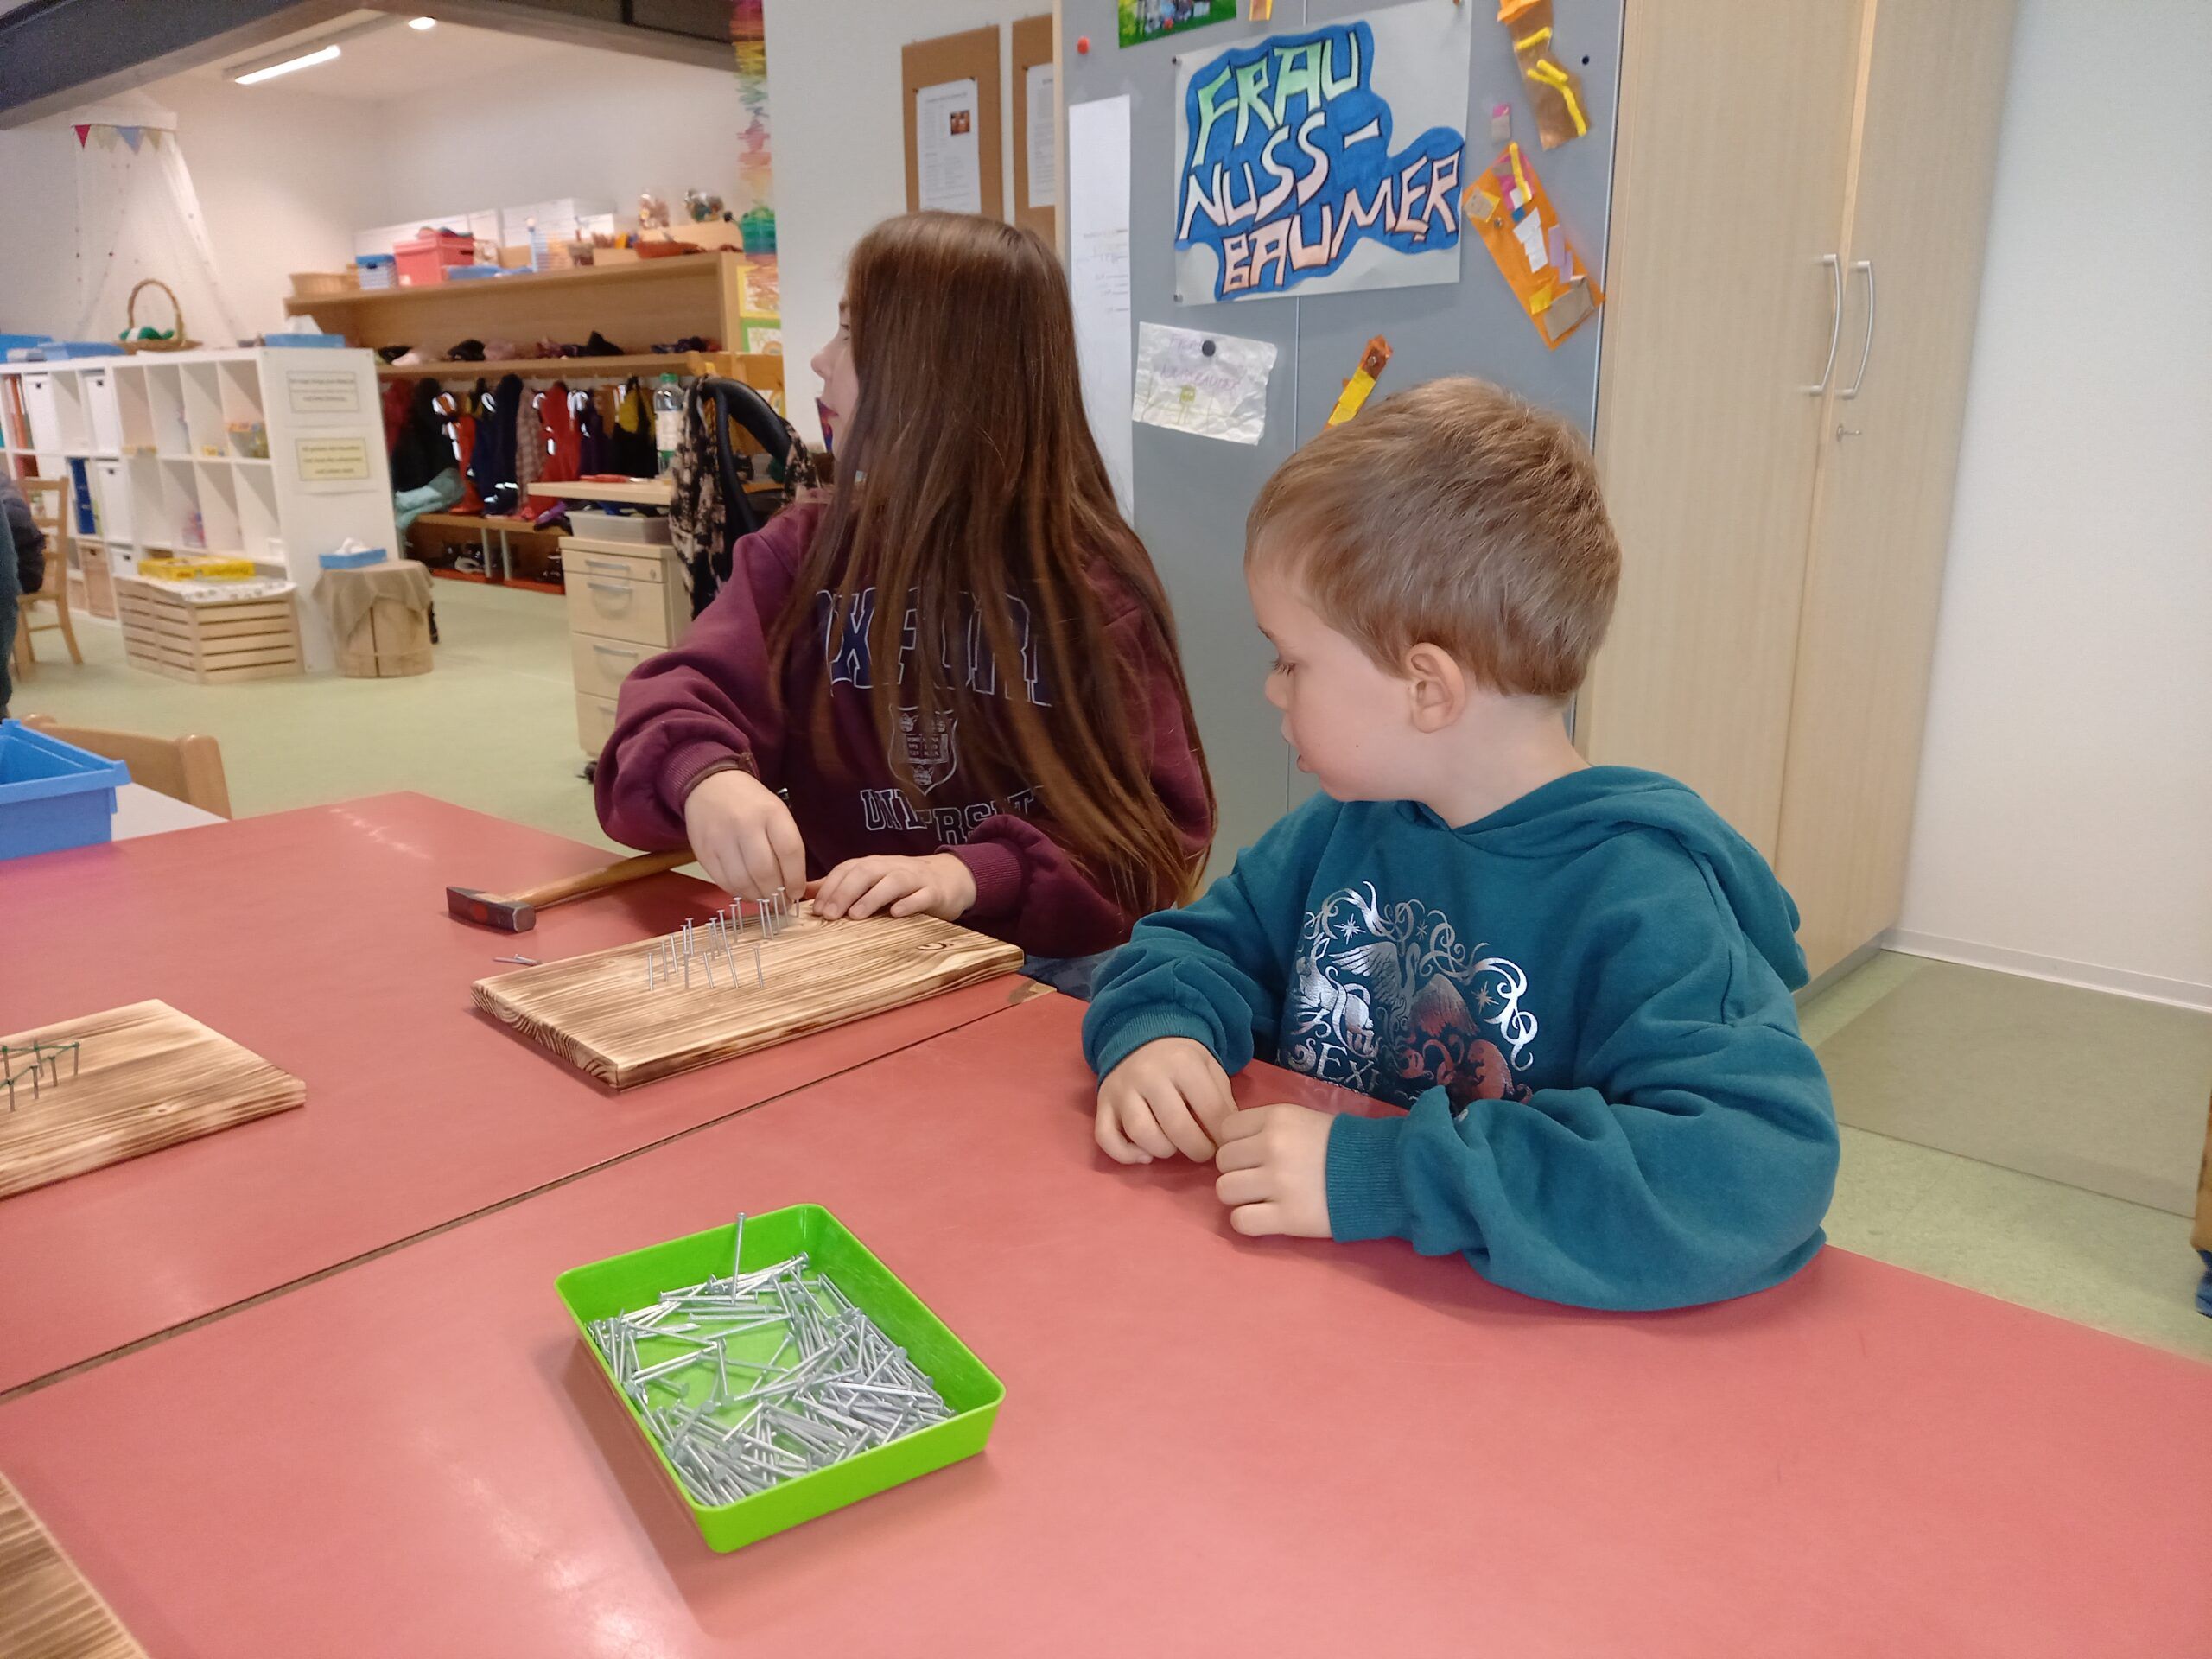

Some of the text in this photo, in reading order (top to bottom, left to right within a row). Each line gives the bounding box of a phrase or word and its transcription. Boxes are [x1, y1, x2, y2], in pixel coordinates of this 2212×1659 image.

[1190, 29, 1360, 168] FRAU
[1178, 110, 1382, 242] NUSS-
[1221, 149, 1462, 296] BAUMER
